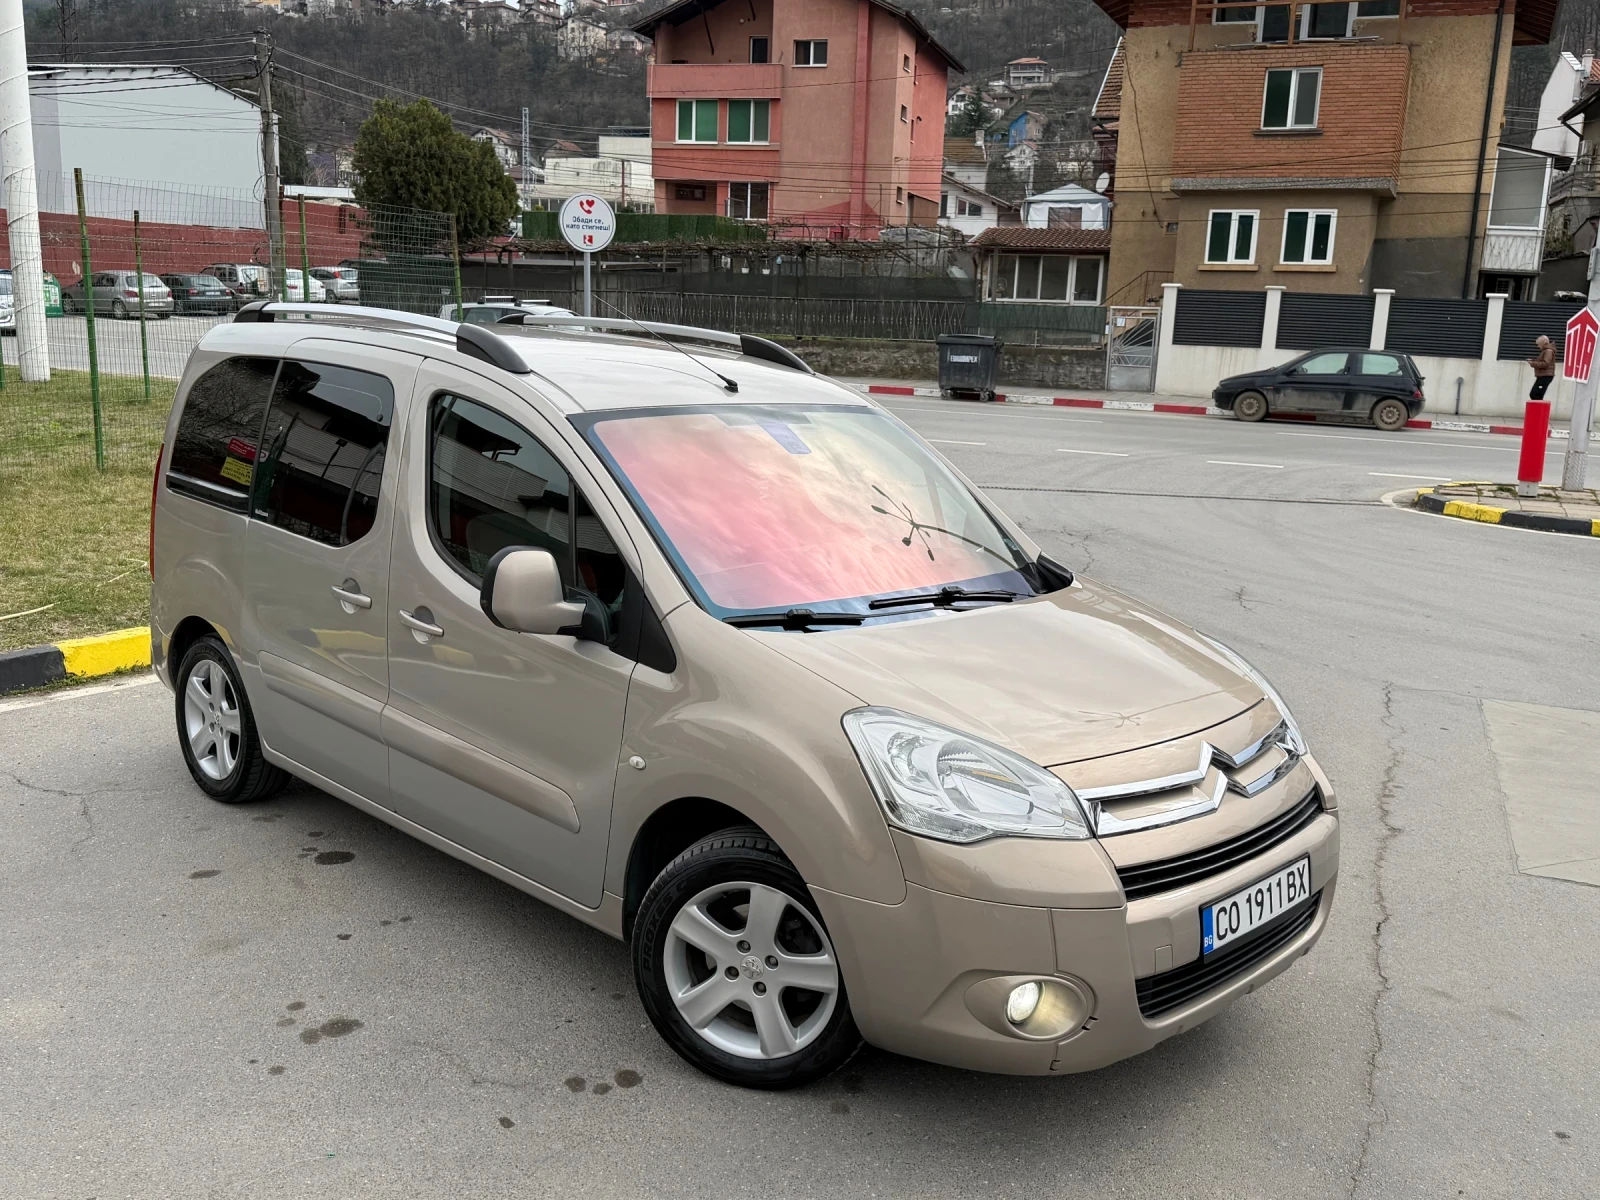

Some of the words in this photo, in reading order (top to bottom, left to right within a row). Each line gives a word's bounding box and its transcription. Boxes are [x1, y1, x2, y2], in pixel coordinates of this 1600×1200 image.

[572, 216, 593, 224] Обади
[1215, 901, 1241, 941] CO
[1246, 876, 1283, 926] 1911
[1287, 863, 1308, 904] BX
[1204, 934, 1213, 948] BG
